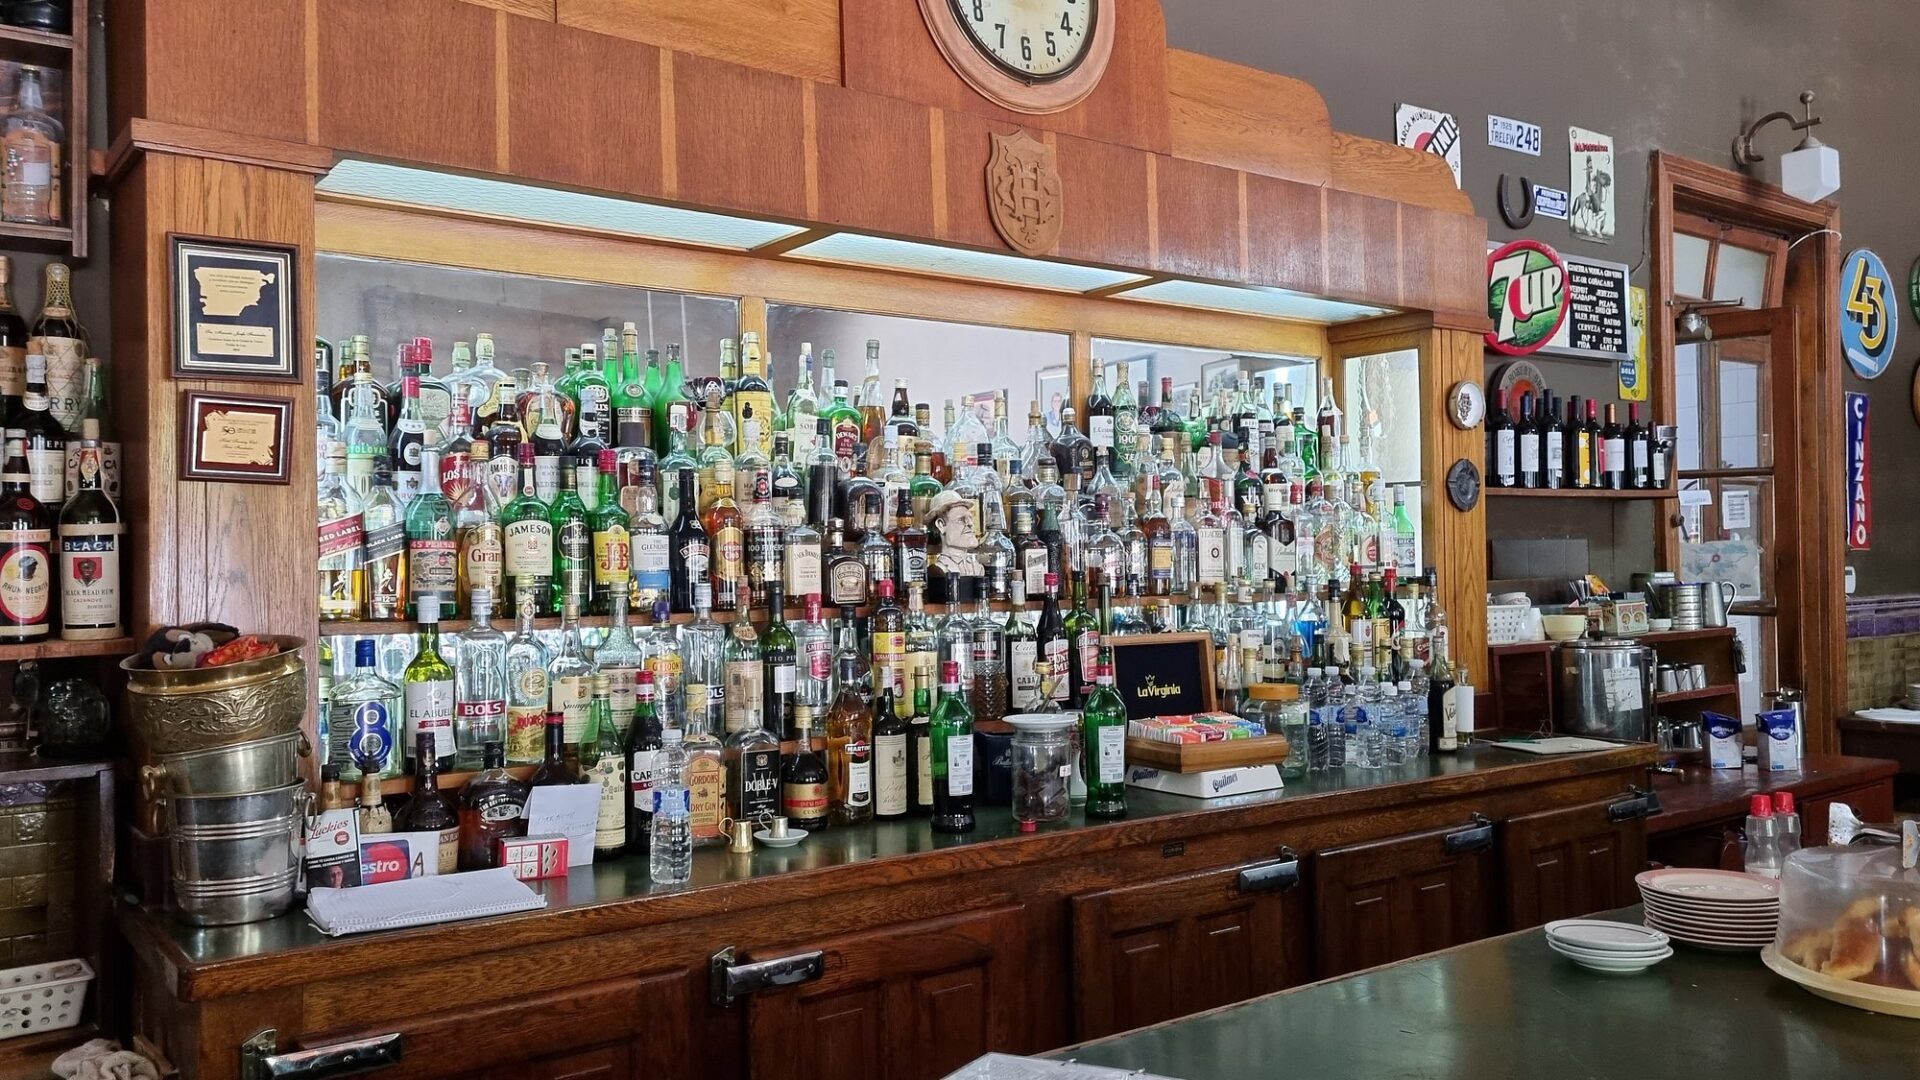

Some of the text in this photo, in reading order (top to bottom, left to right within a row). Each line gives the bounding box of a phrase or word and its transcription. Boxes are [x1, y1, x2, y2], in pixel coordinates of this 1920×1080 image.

[1060, 11, 1073, 36] 4
[994, 23, 1006, 49] 7
[1045, 31, 1056, 56] 5
[1020, 36, 1032, 61] 6
[1492, 119, 1498, 129] P
[1491, 130, 1516, 146] TRELEW
[1516, 125, 1540, 152] 248
[1847, 258, 1886, 350] 43
[442, 469, 460, 483] LOS
[1854, 398, 1867, 545] CINZANO
[319, 526, 362, 542] RED LABEL
[509, 524, 551, 537] JAMESON
[64, 541, 114, 551] BLACK
[411, 541, 422, 549] 45
[748, 544, 760, 552] 100
[2, 582, 20, 594] RHUM
[708, 687, 725, 698] OLS
[410, 708, 451, 718] EL ABUEL
[464, 703, 502, 715] BOLS
[1212, 772, 1239, 793] Quilmes
[690, 801, 716, 812] DRY GIN
[308, 819, 350, 842] Luckies
[361, 859, 400, 875] estro
[412, 851, 425, 877] A
